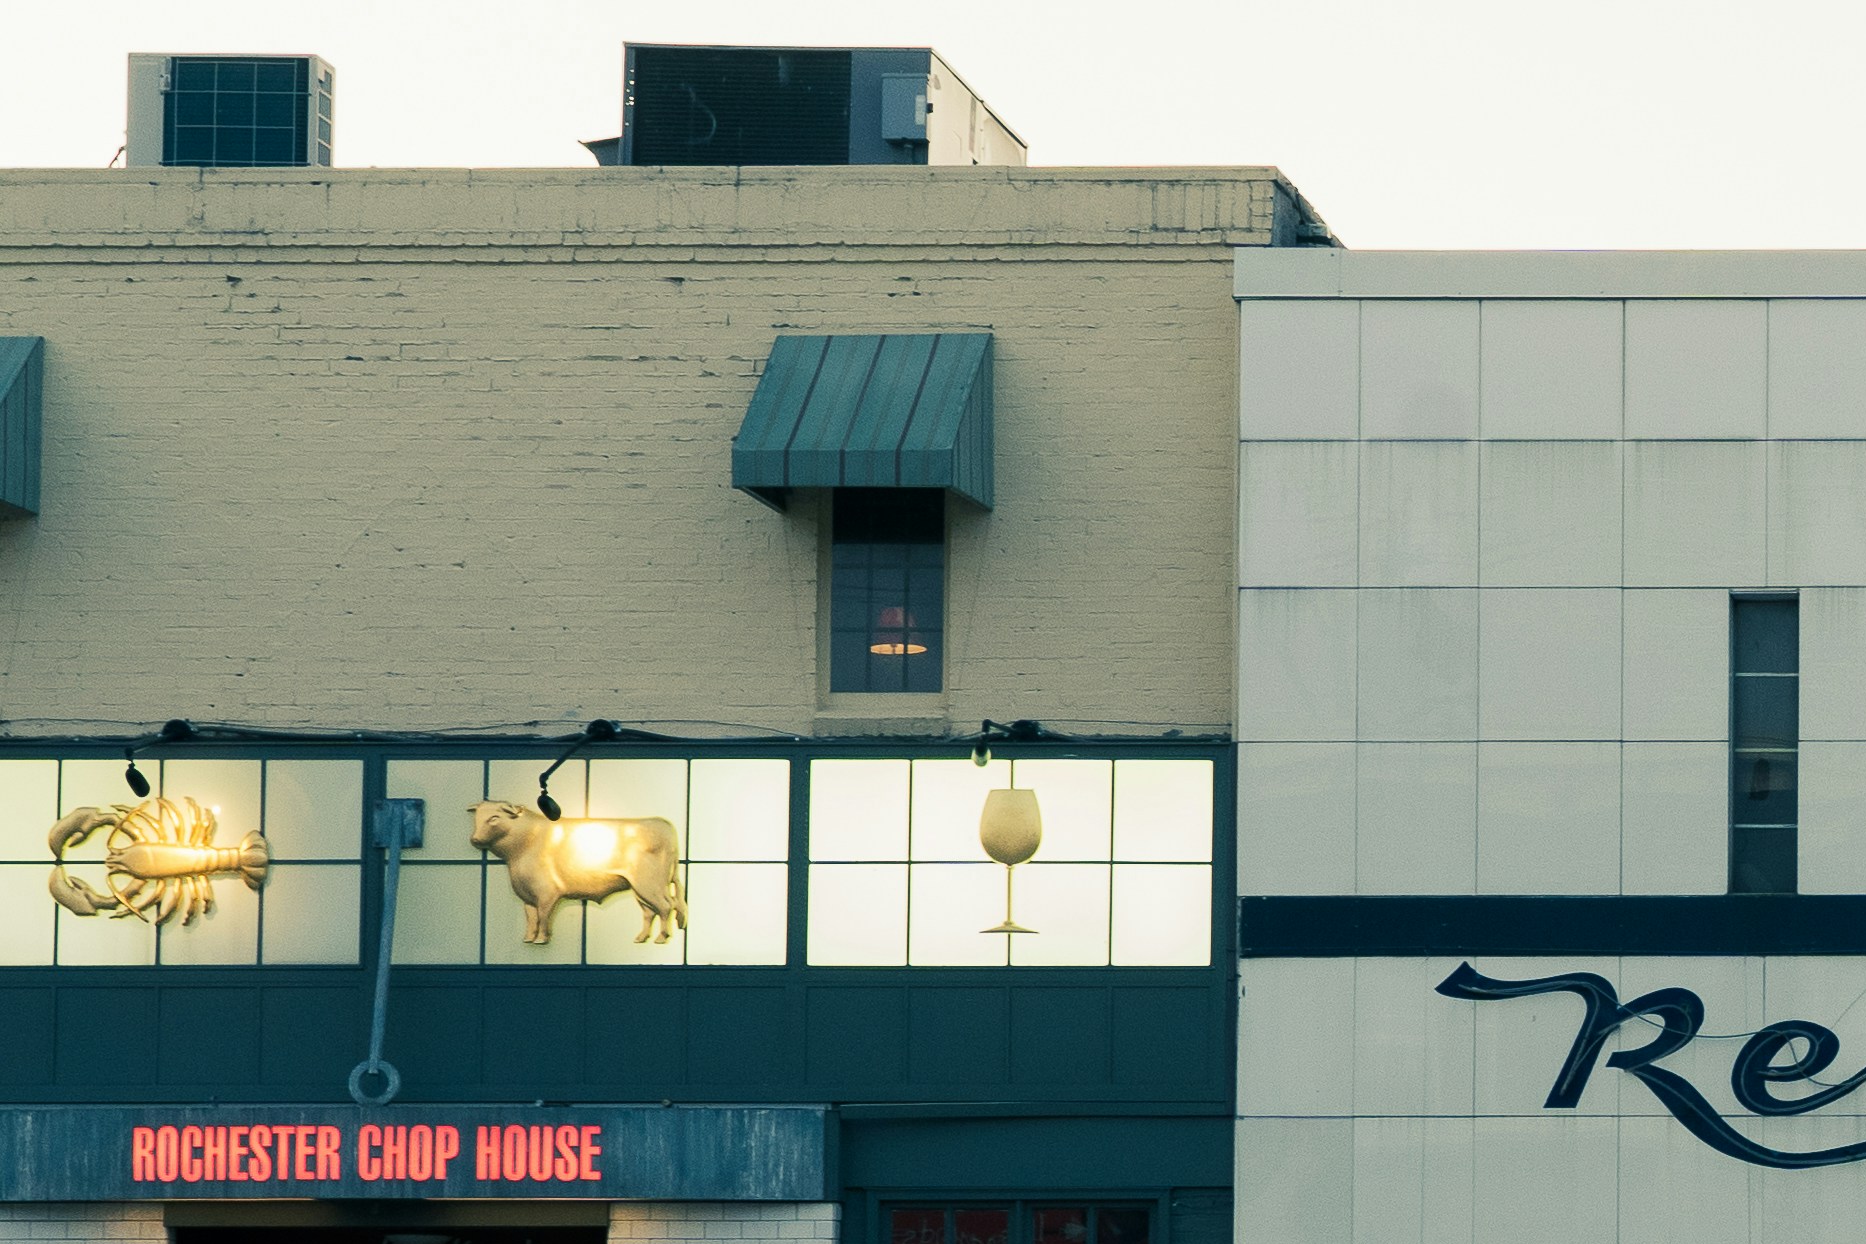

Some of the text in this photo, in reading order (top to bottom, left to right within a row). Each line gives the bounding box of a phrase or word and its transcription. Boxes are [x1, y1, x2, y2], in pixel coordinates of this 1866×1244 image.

[132, 1124, 603, 1183] ROCHESTER CHOP HOUSE
